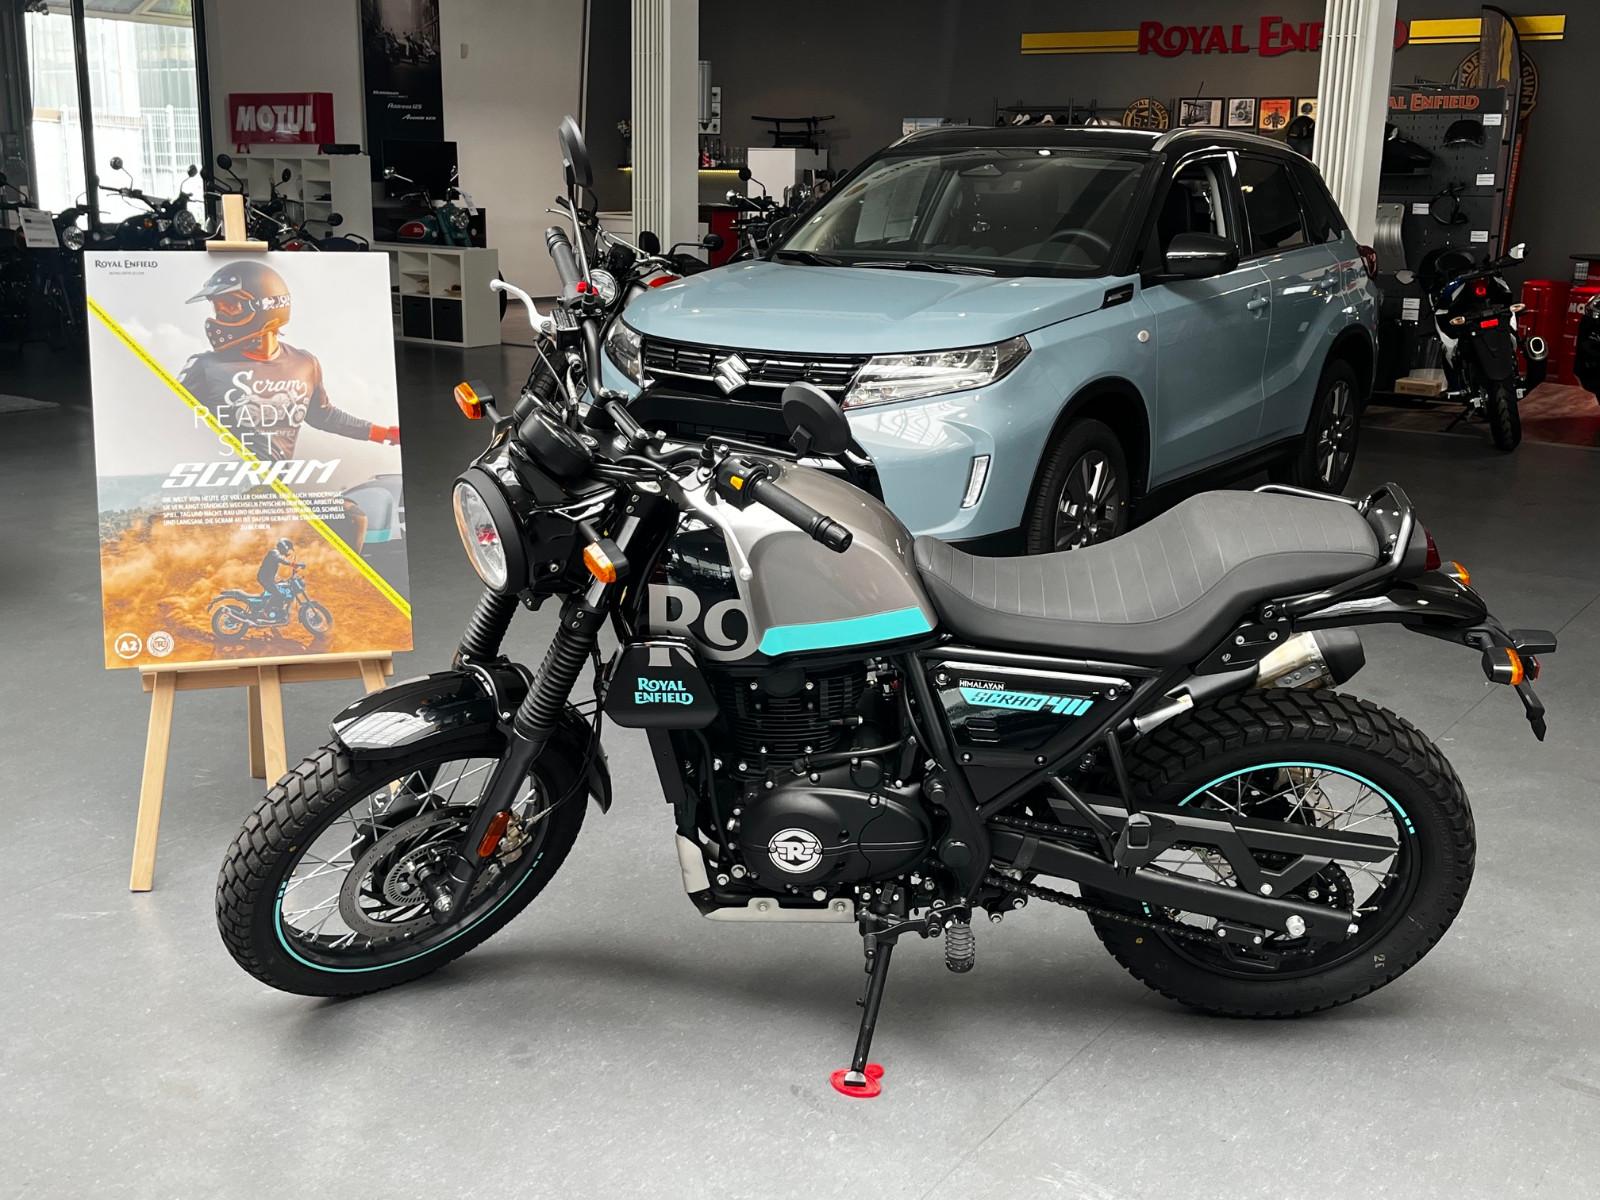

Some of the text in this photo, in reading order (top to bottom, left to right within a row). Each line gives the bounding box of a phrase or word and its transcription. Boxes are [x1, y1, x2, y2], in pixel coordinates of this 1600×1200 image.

[1138, 21, 1249, 58] ROYAL
[1410, 93, 1480, 112] ENFIELD
[236, 105, 316, 134] MOTUL
[95, 259, 158, 269] ROYAL ENFIELD
[224, 370, 307, 407] Scram
[218, 432, 285, 456] SET.
[161, 458, 342, 489] SCRAM
[120, 640, 138, 652] A2
[637, 677, 686, 692] ROYAL
[959, 679, 1005, 691] HIMALAYAN
[634, 691, 694, 705] ENFIELD
[972, 690, 1043, 708] SCRAM
